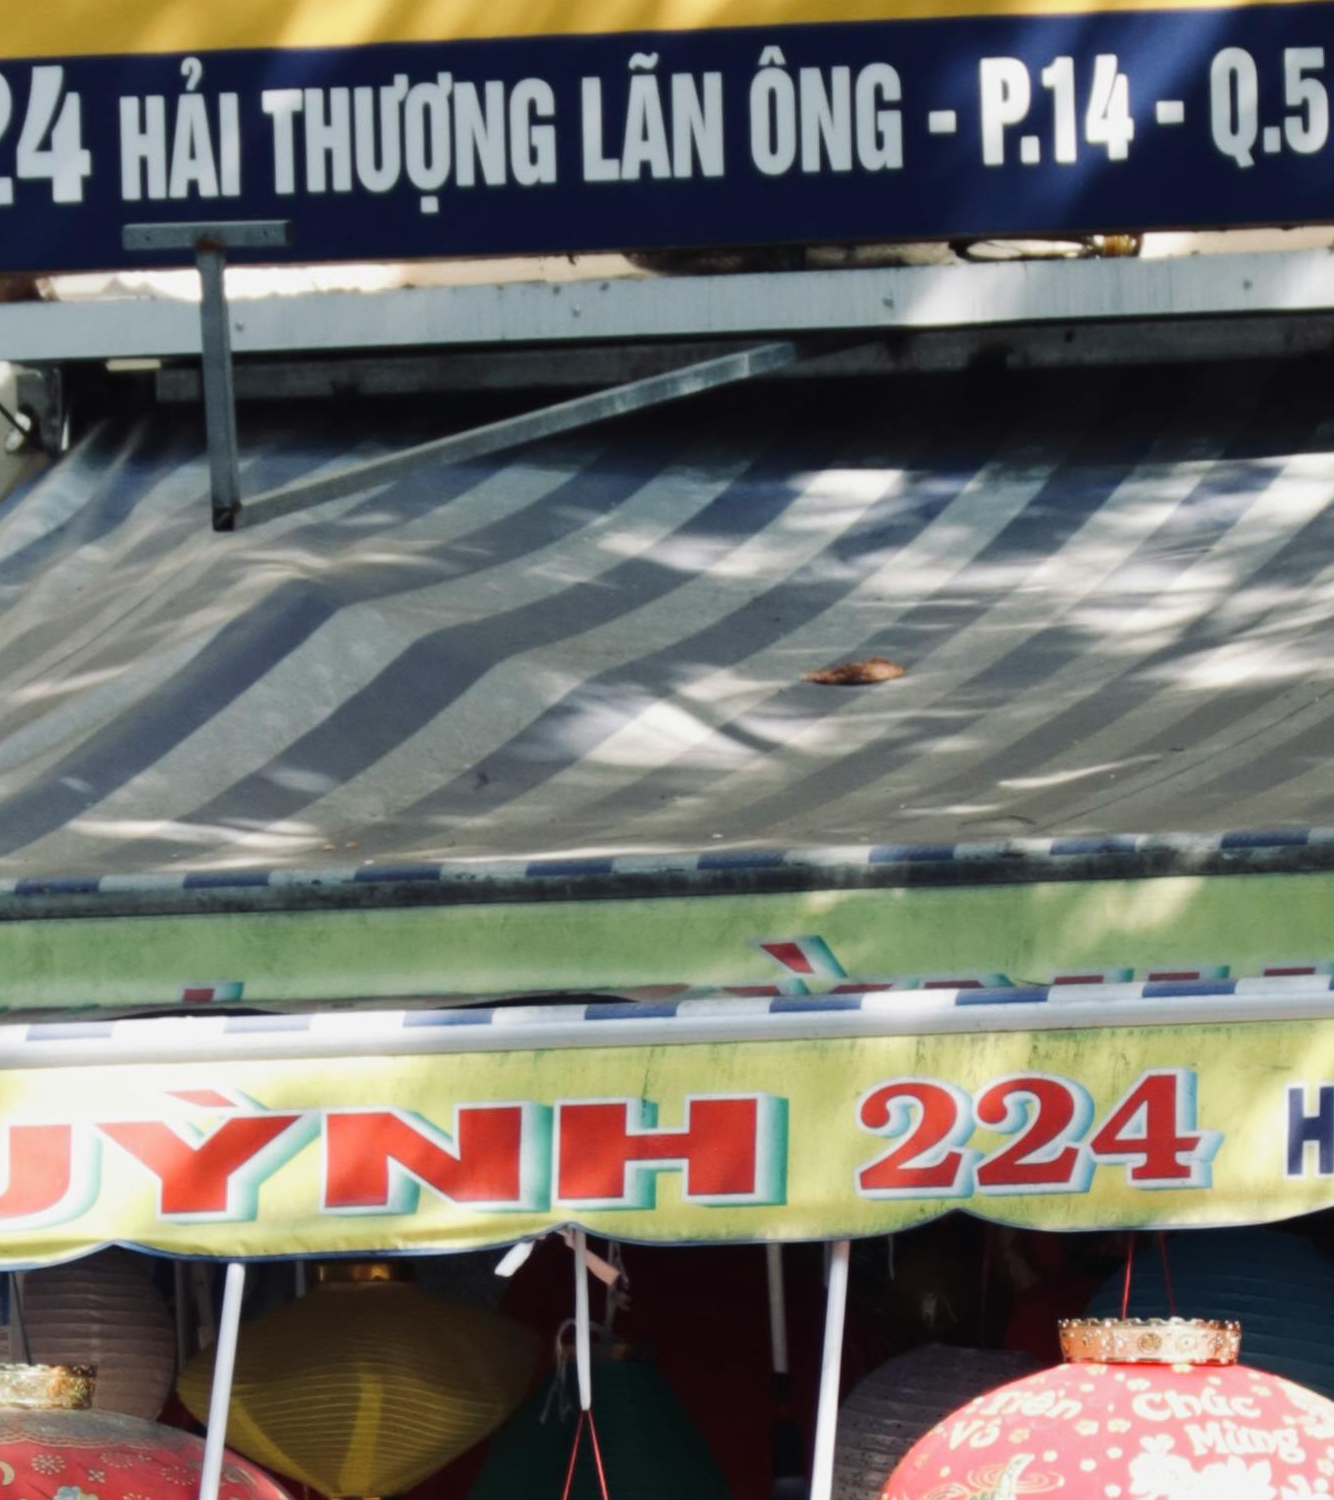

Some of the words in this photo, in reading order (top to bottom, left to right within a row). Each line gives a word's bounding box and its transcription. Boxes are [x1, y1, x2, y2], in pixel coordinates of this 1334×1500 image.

[117, 56, 243, 201] HẢI
[263, 75, 559, 216] THƯỢNG
[579, 52, 727, 186] LÃN
[748, 44, 905, 176] ÔNG
[979, 55, 1137, 166] P.14
[1207, 46, 1333, 170] Q.5
[854, 1067, 1227, 1198] 224
[1131, 1386, 1262, 1421] Chúc
[1183, 1421, 1307, 1464] Mừng
